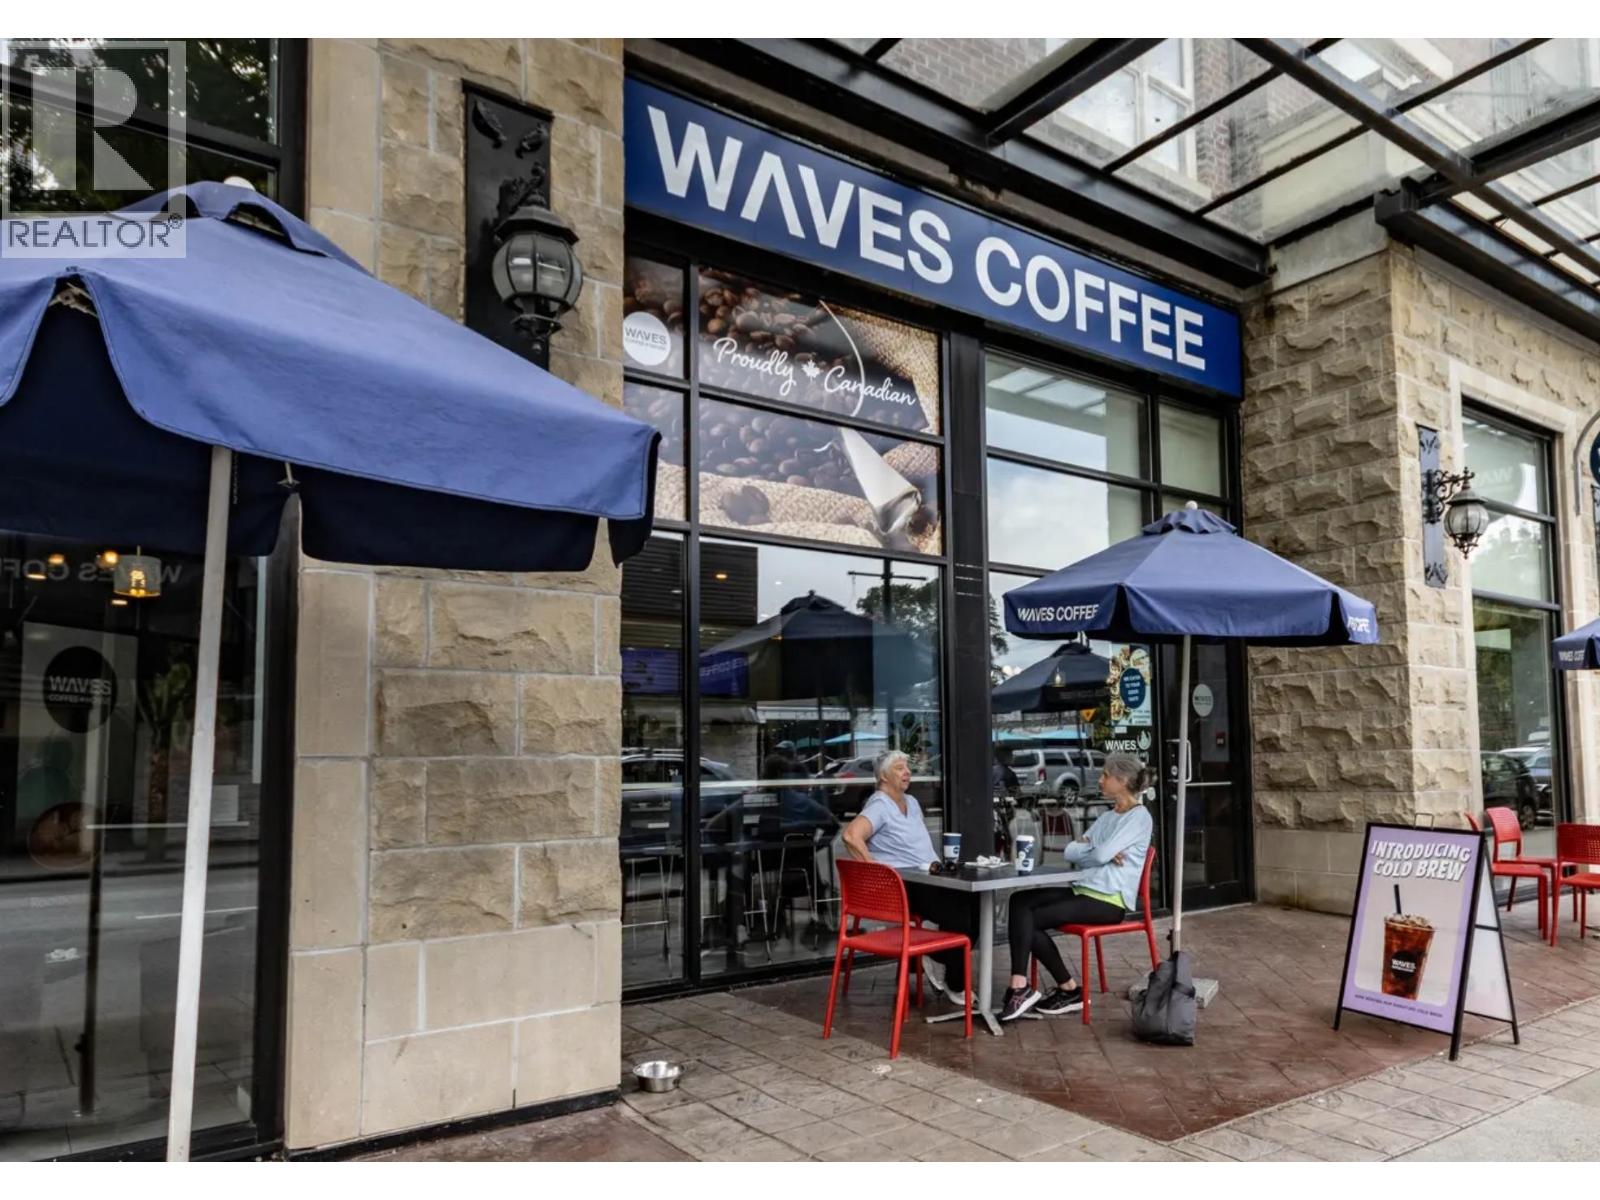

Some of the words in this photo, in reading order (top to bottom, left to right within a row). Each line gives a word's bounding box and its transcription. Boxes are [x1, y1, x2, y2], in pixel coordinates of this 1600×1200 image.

[647, 105, 953, 285] WAVES
[975, 237, 1206, 371] COFFEE
[625, 326, 667, 345] WAVES
[713, 337, 797, 396] Proudly
[824, 365, 916, 406] Canadian
[1018, 606, 1055, 621] WAVES
[49, 675, 112, 695] WAVES
[1105, 740, 1137, 751] WAVES
[1371, 840, 1472, 863] INTRODUCING
[1374, 860, 1413, 878] COLD
[1416, 860, 1466, 881] BREW
